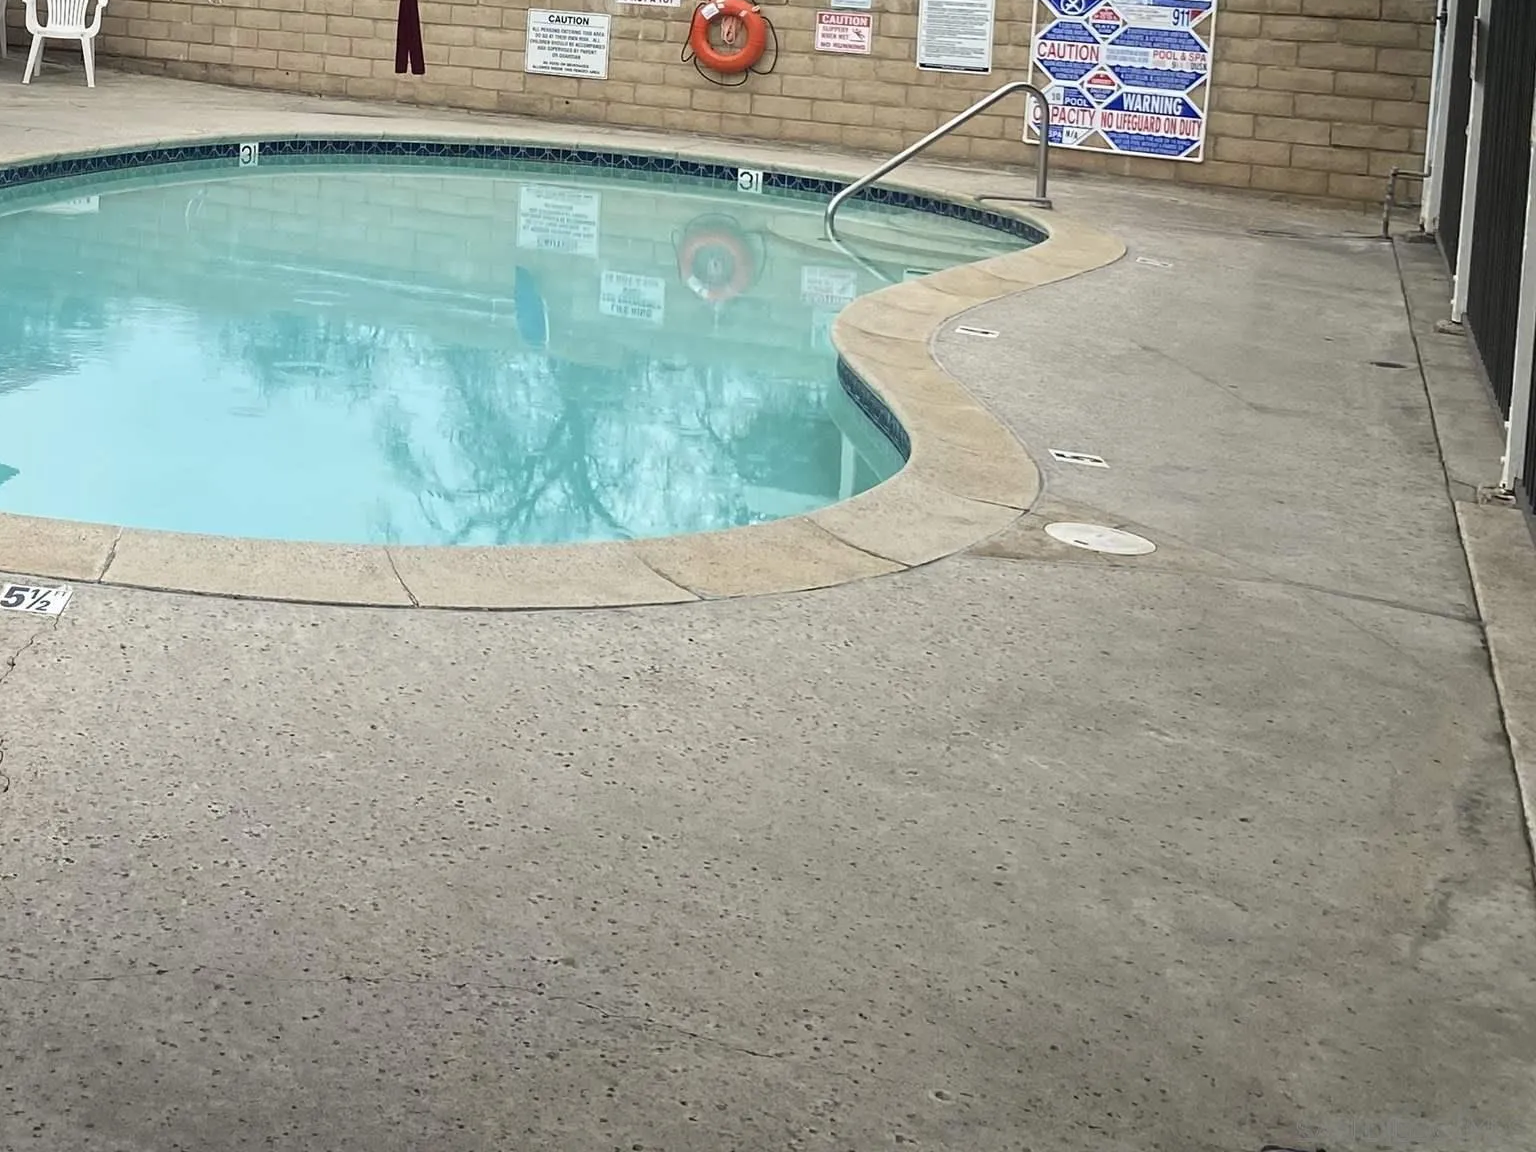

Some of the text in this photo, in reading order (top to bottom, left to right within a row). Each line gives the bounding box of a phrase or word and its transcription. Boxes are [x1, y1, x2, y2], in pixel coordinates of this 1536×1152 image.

[548, 14, 590, 25] CAUTION
[822, 14, 868, 26] CAUTION
[1172, 8, 1190, 26] 911
[1037, 41, 1100, 61] CAUTION
[1153, 50, 1178, 61] POOL
[1188, 54, 1207, 63] SPA
[1065, 97, 1089, 107] POOL
[1123, 93, 1183, 116] WARNING
[1033, 105, 1096, 127] CPACITY
[1101, 112, 1203, 137] NO LIFEGUARD ON DUTY
